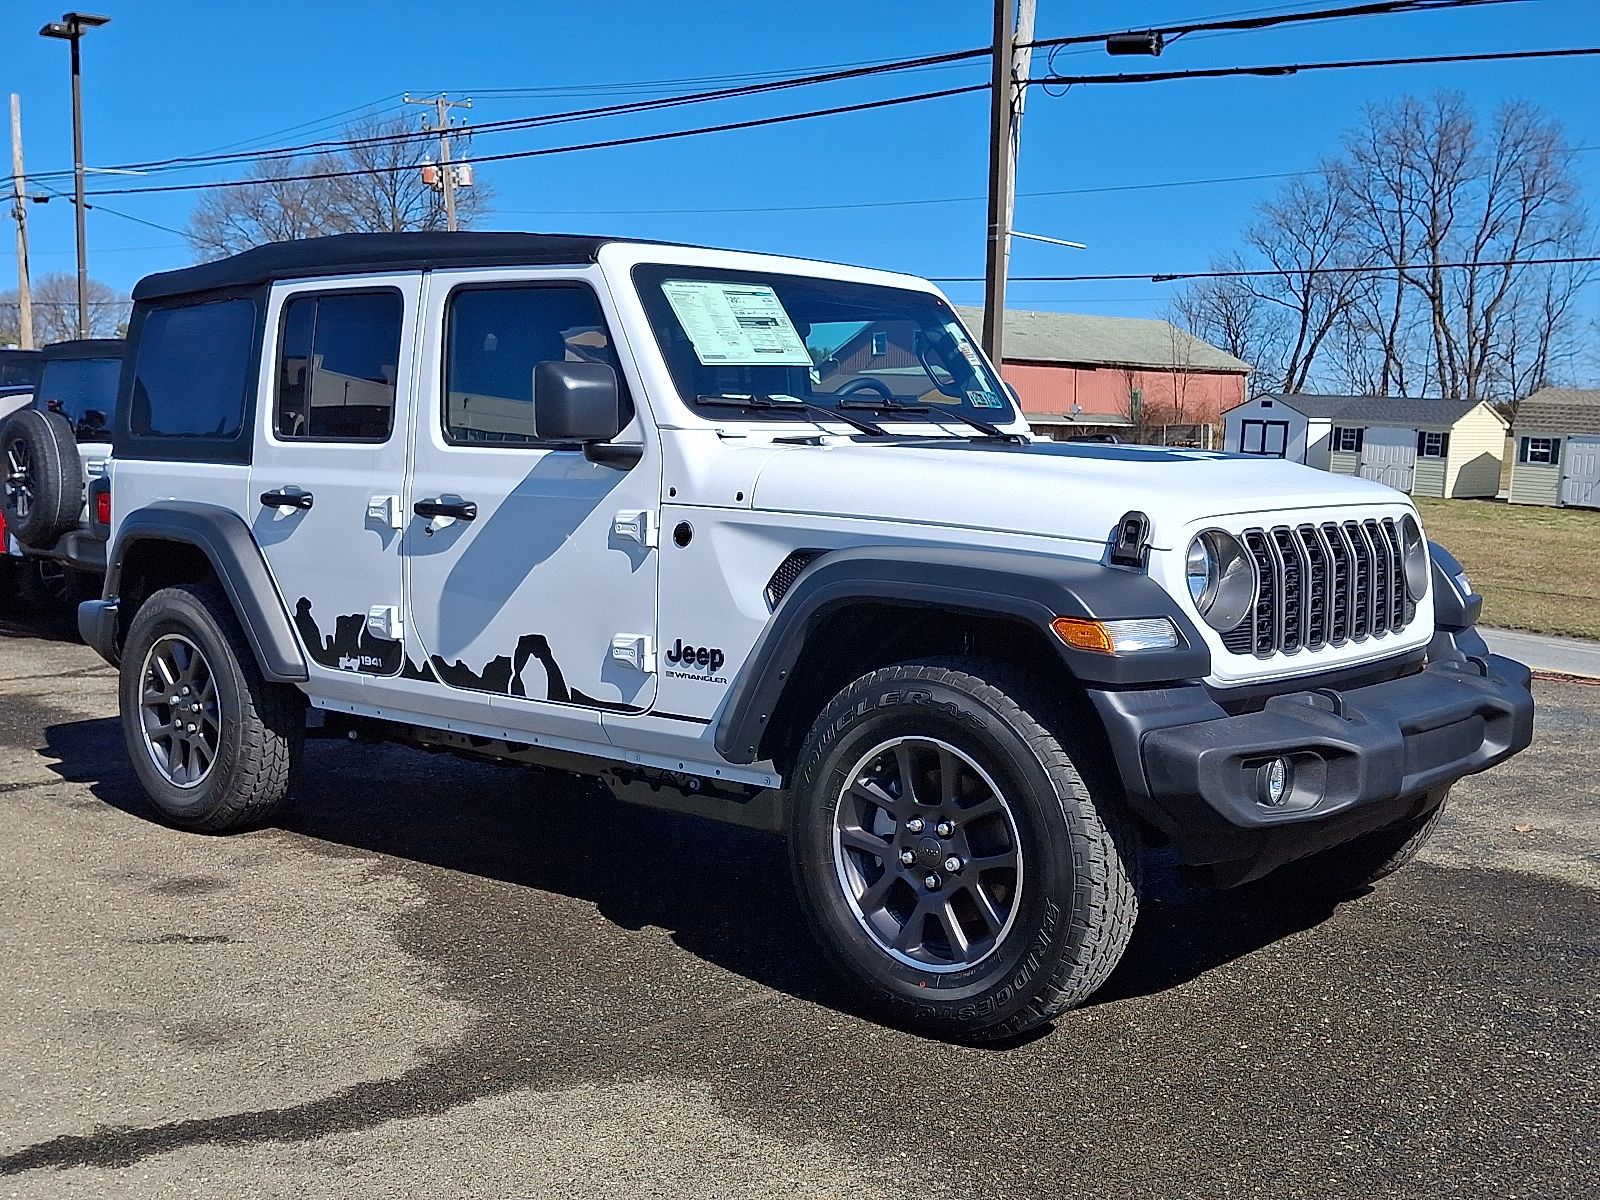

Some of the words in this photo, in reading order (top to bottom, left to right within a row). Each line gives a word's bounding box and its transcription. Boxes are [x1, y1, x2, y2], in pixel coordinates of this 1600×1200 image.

[361, 655, 382, 668] 1941
[664, 638, 725, 675] Jeep
[675, 671, 728, 685] WRANGLER
